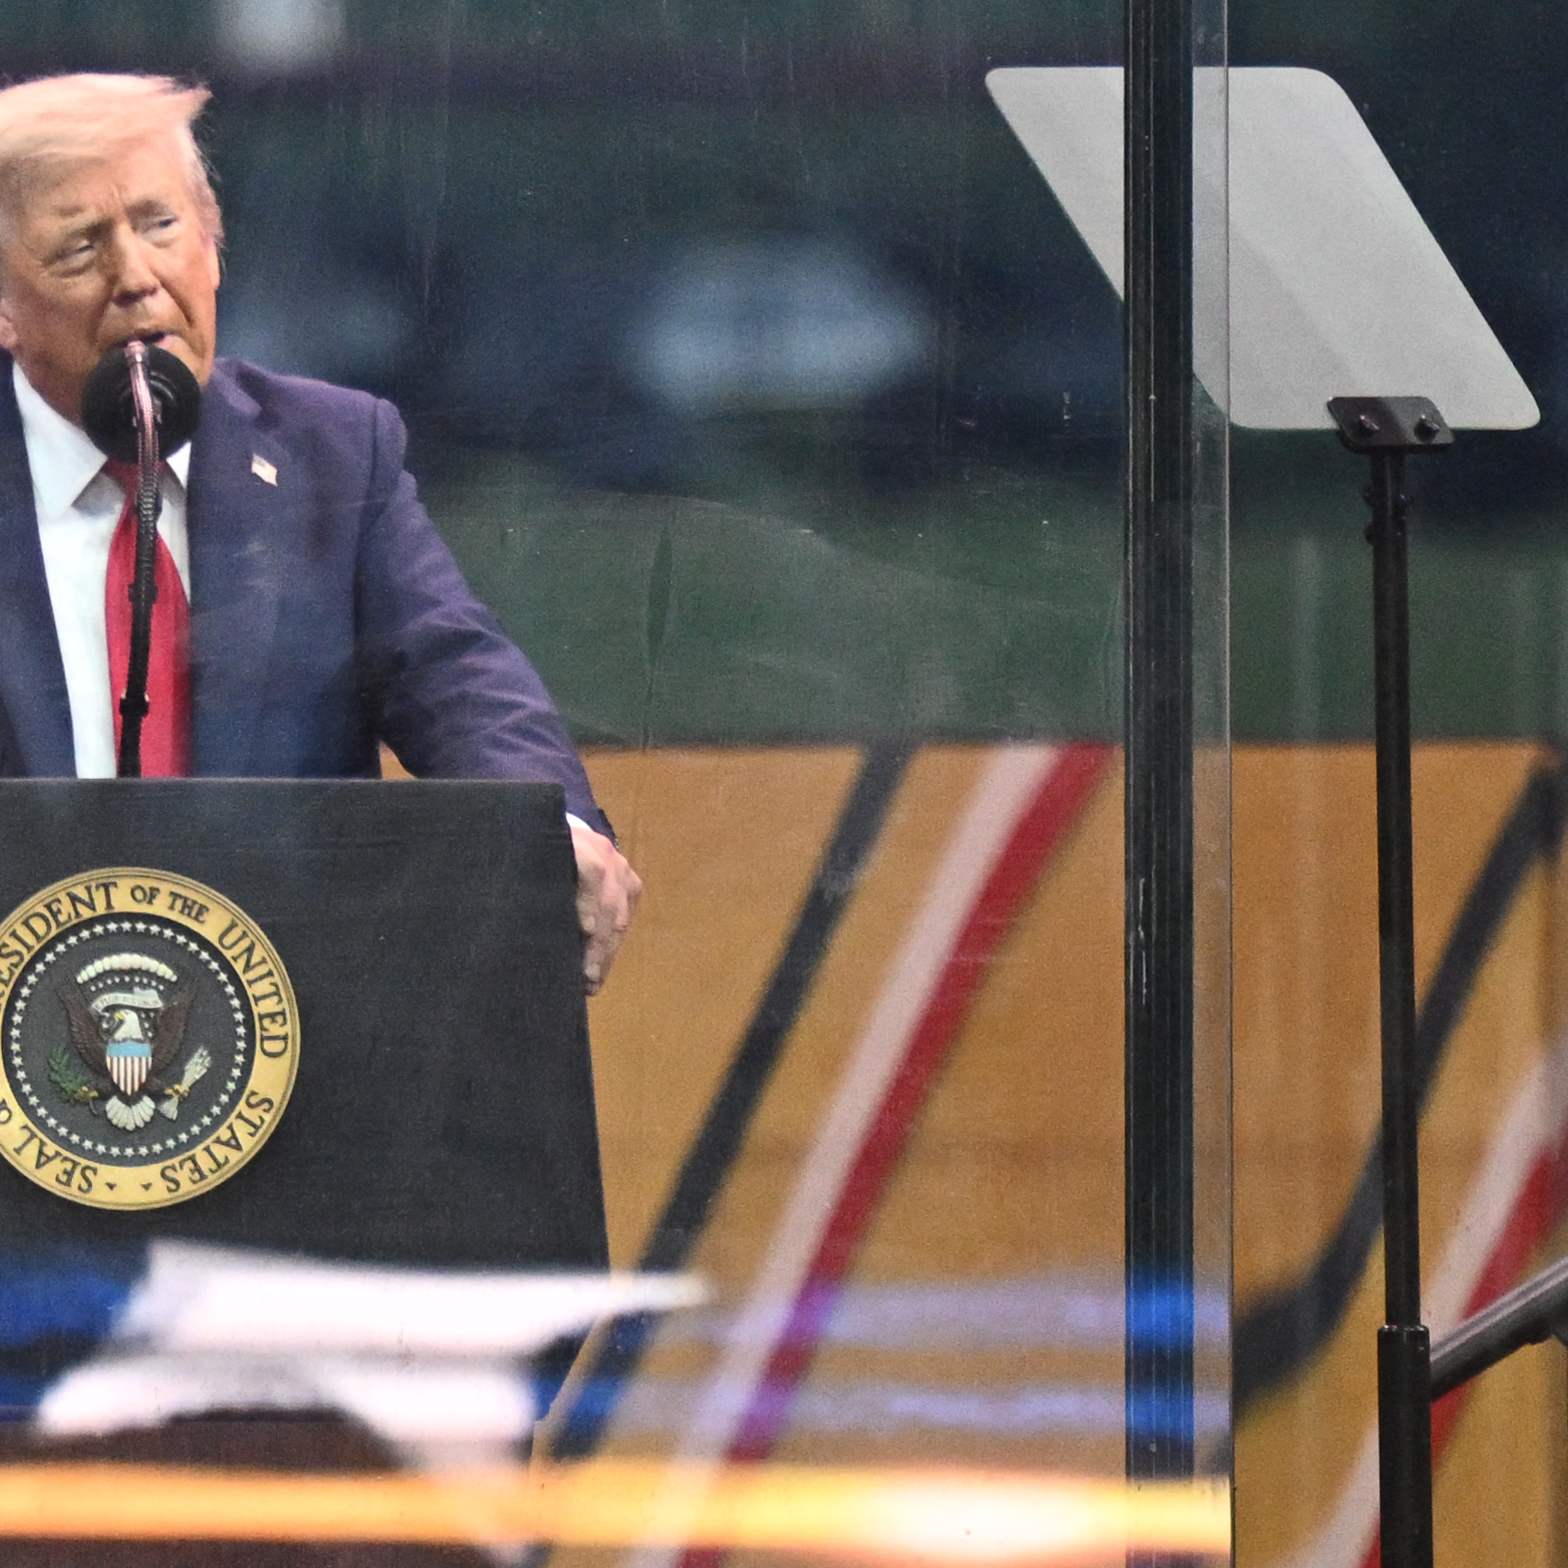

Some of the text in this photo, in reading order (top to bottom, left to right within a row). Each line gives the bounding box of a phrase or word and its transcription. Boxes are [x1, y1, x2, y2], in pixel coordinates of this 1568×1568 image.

[131, 884, 159, 907] OF
[167, 892, 210, 924] THE
[218, 919, 289, 1058] UNITED
[13, 1123, 98, 1194] SEAL
[159, 1090, 274, 1193] STATES
